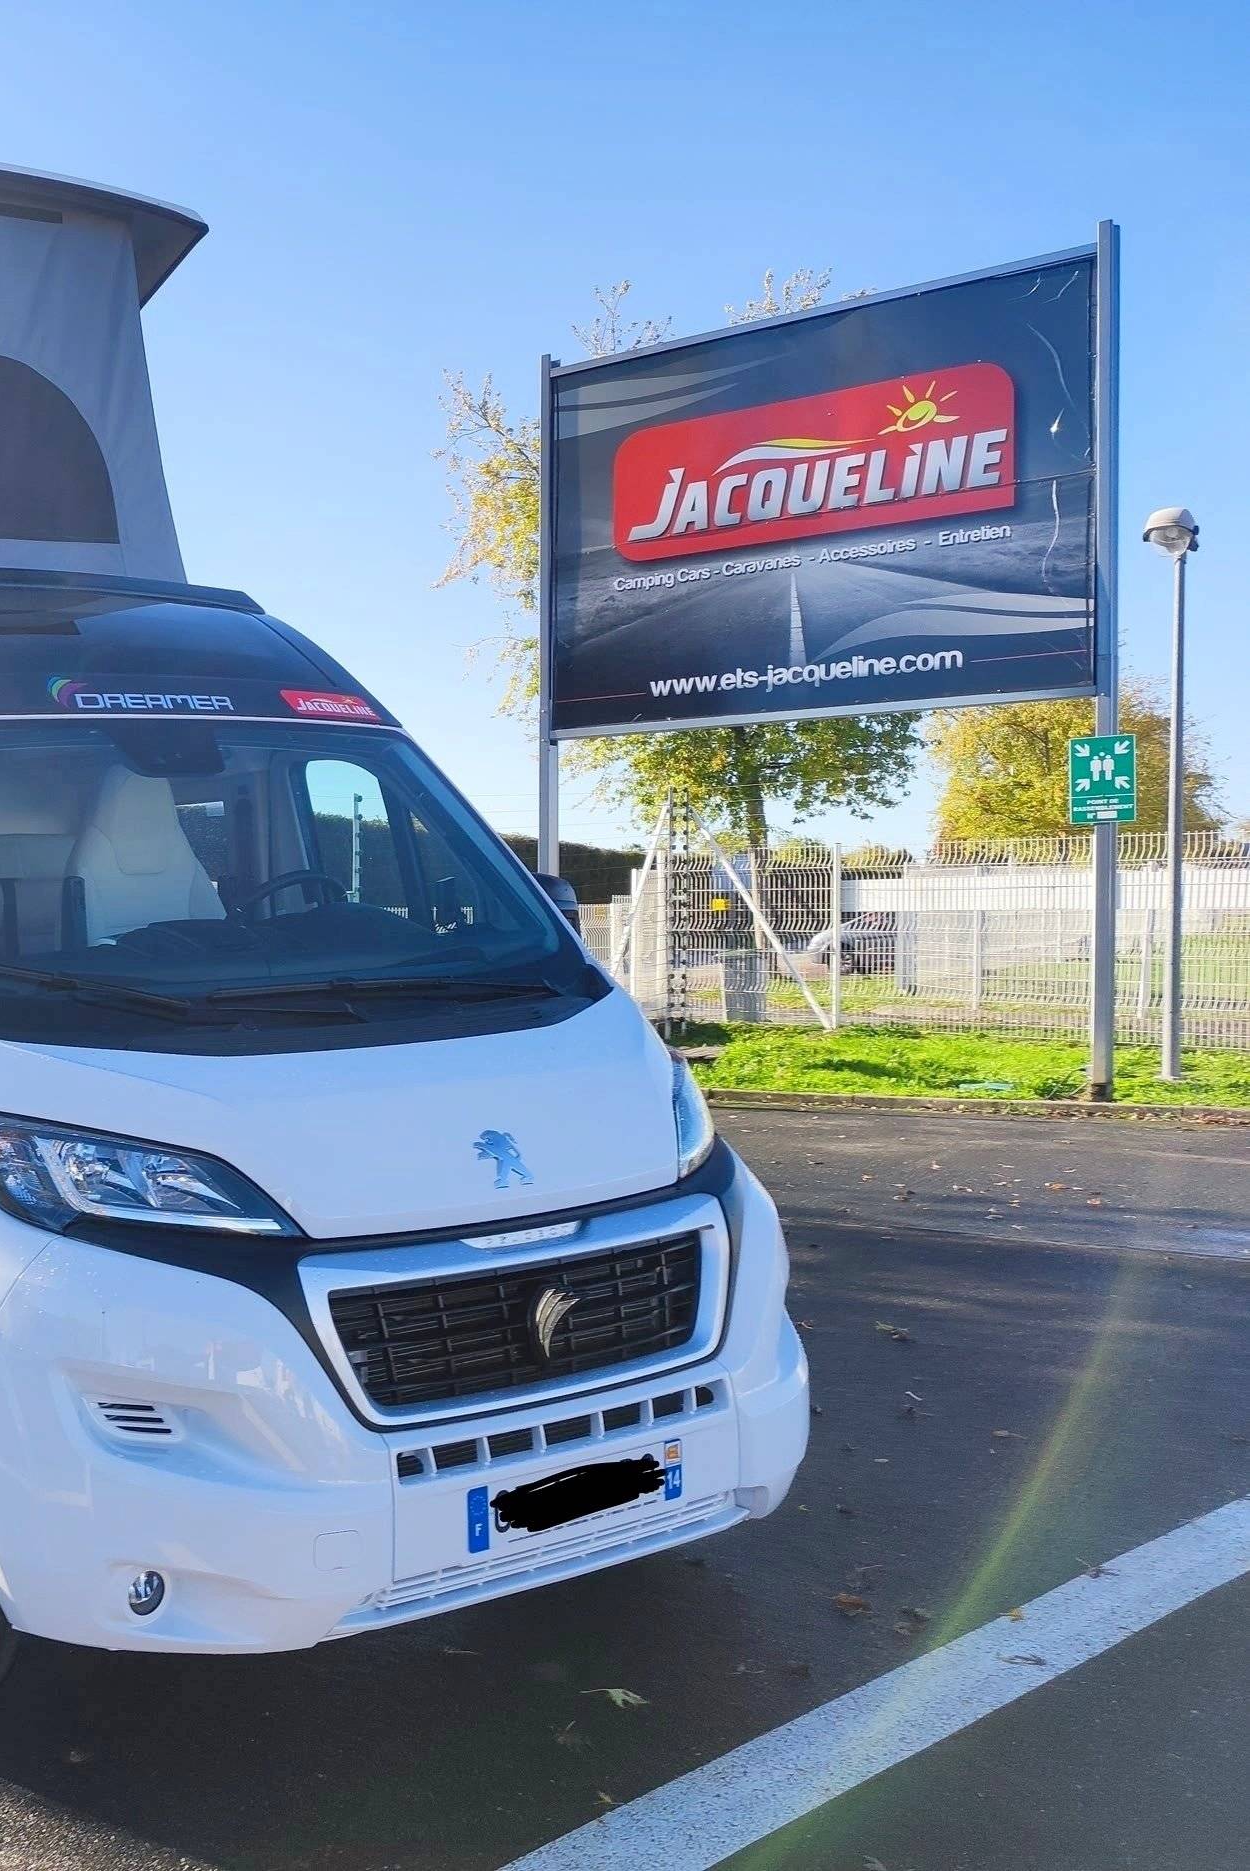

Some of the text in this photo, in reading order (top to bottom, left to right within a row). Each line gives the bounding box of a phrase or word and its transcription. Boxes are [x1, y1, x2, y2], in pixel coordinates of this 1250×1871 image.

[626, 429, 1008, 542] JACQUELINE
[613, 573, 675, 591] Camping
[677, 567, 711, 583] Cars
[721, 554, 801, 577] Caravanes
[819, 537, 917, 563] Accessoires
[939, 524, 1011, 546] Entretien
[650, 650, 963, 698] www.ets-jacqueline.com
[74, 693, 235, 711] DREAMER
[297, 698, 376, 716] JACQUELINE
[667, 1468, 680, 1490] 14
[475, 1523, 483, 1537] F
